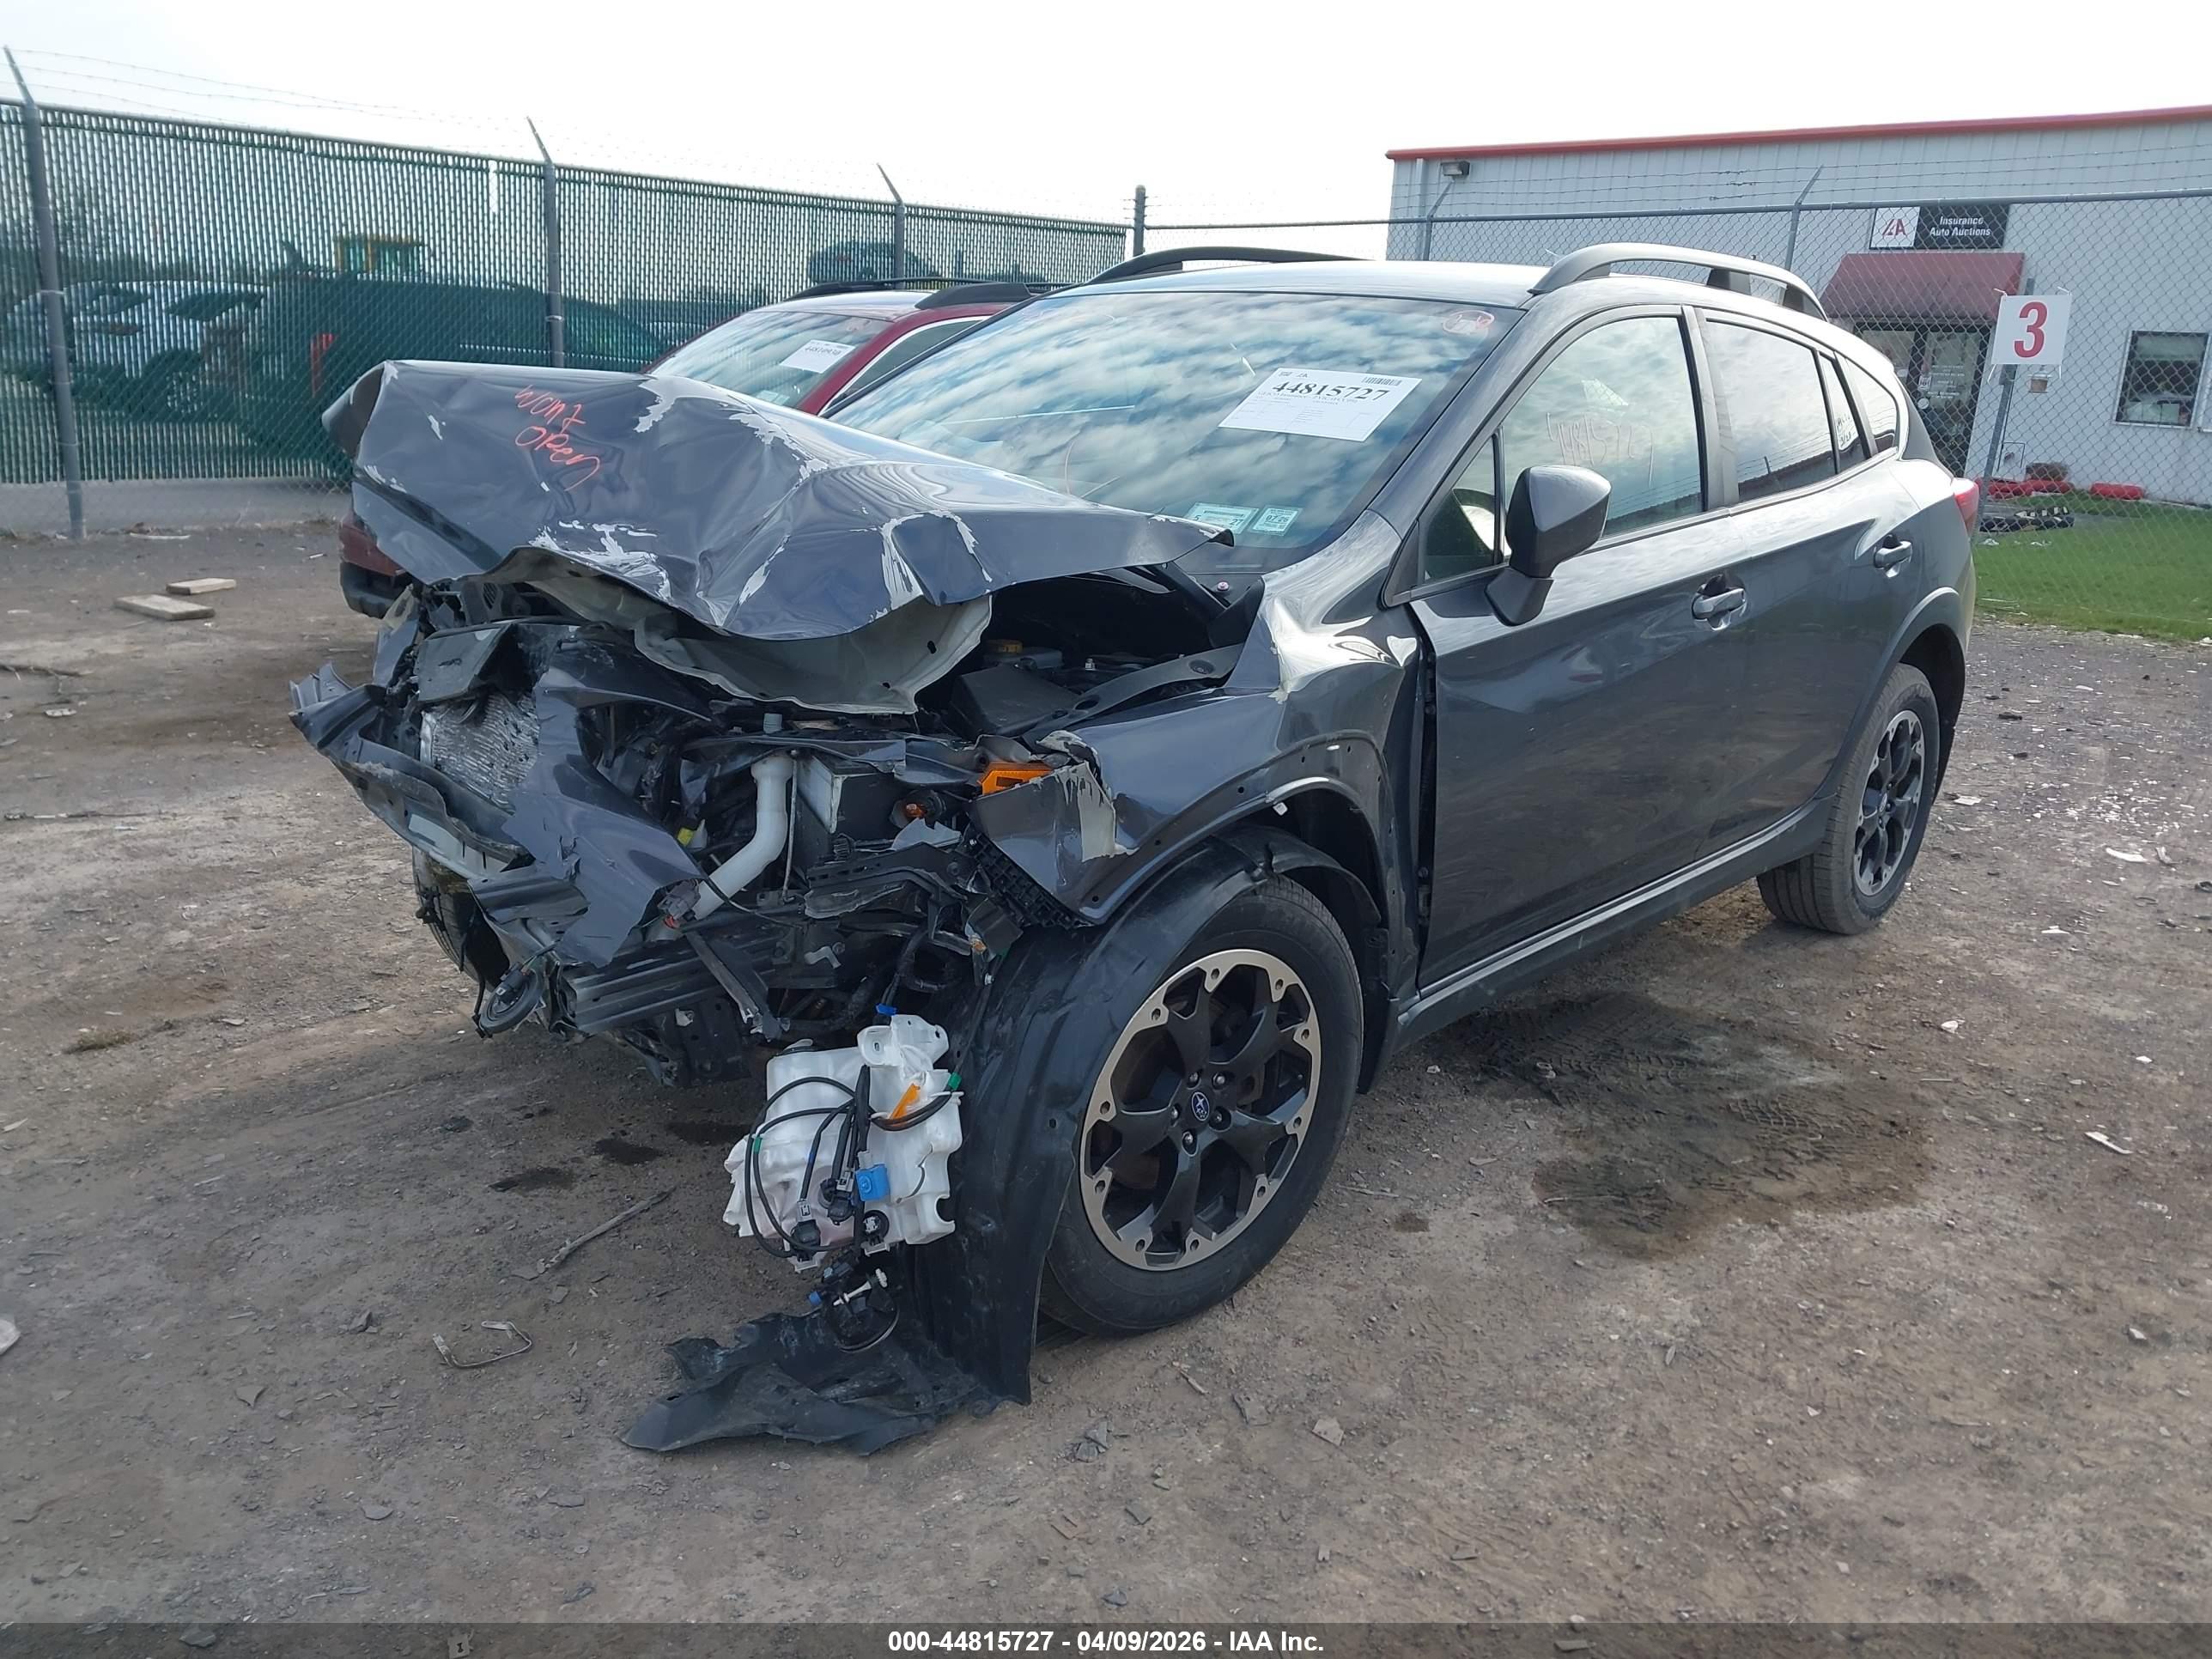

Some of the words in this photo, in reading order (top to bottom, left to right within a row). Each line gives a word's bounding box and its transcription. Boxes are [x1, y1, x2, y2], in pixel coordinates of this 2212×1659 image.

[1939, 216, 1984, 225] Insurance
[1931, 227, 1950, 236] Auto
[1951, 227, 1991, 236] Auctions
[2014, 301, 2048, 358] 3
[1272, 380, 1390, 401] 44815727
